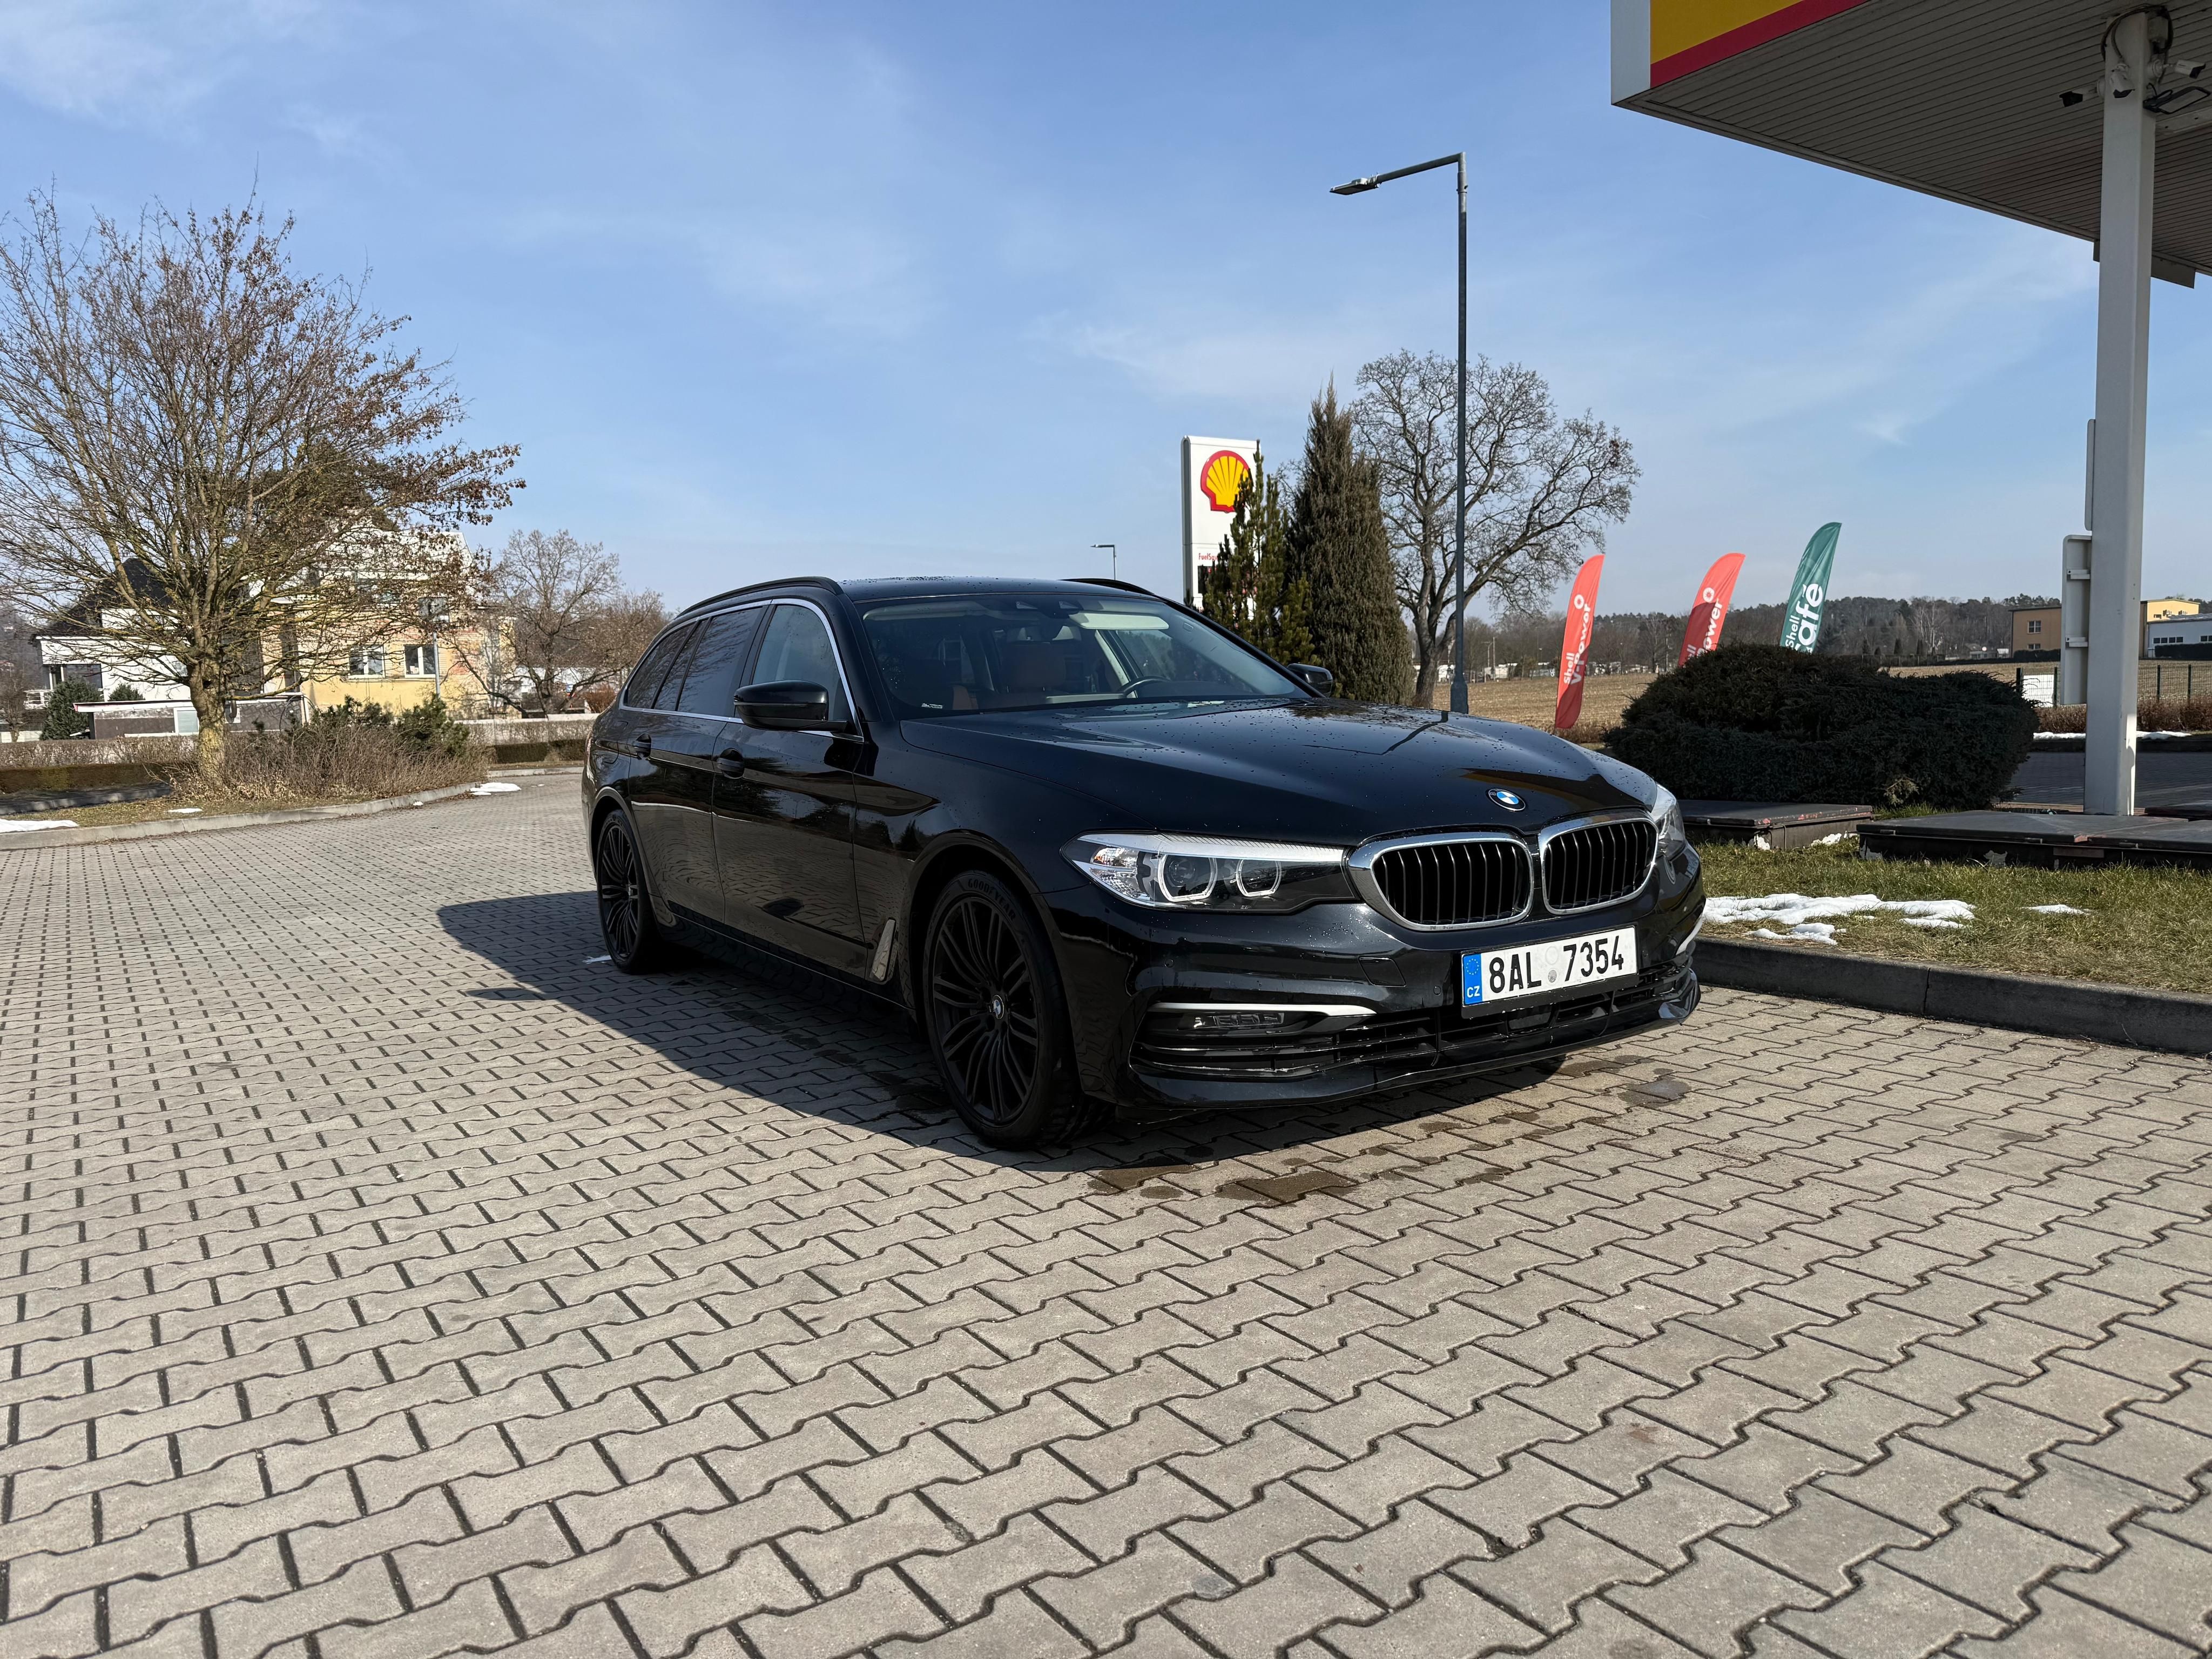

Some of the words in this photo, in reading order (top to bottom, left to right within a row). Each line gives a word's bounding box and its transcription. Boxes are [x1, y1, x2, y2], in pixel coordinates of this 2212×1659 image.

[1570, 604, 1590, 685] V-Power
[1785, 615, 1799, 649] Shell
[1564, 652, 1575, 684] Shell
[1489, 952, 1541, 993] 8AL
[1563, 935, 1623, 981] 7354
[1467, 985, 1480, 998] CZ
